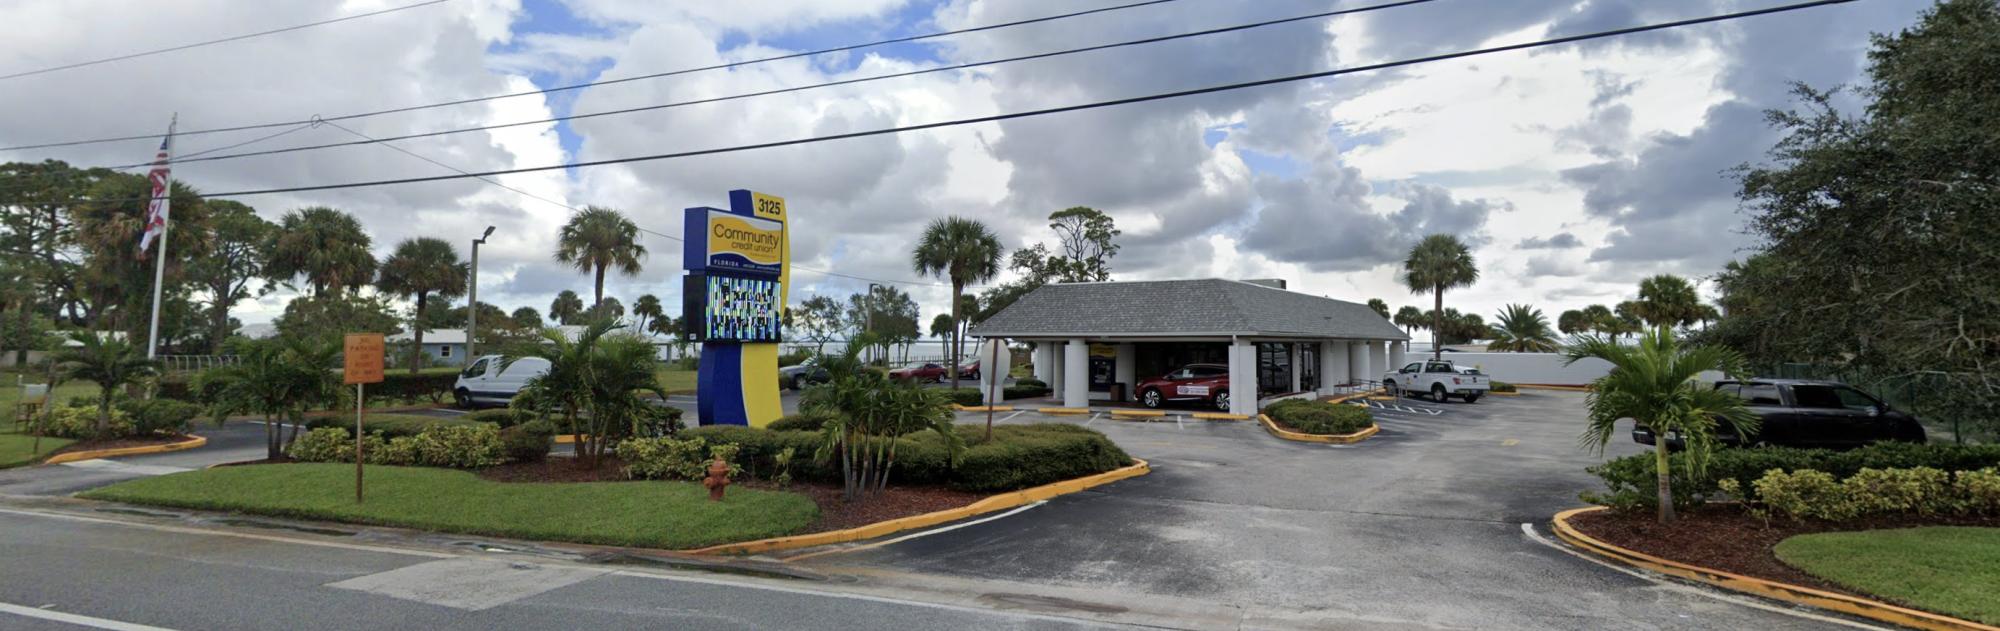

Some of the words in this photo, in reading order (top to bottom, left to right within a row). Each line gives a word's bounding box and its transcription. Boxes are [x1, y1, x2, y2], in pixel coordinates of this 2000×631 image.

[759, 199, 780, 215] 3125
[714, 224, 779, 249] Community
[731, 242, 753, 250] credit
[753, 244, 774, 253] union
[714, 259, 739, 267] FLORIDA
